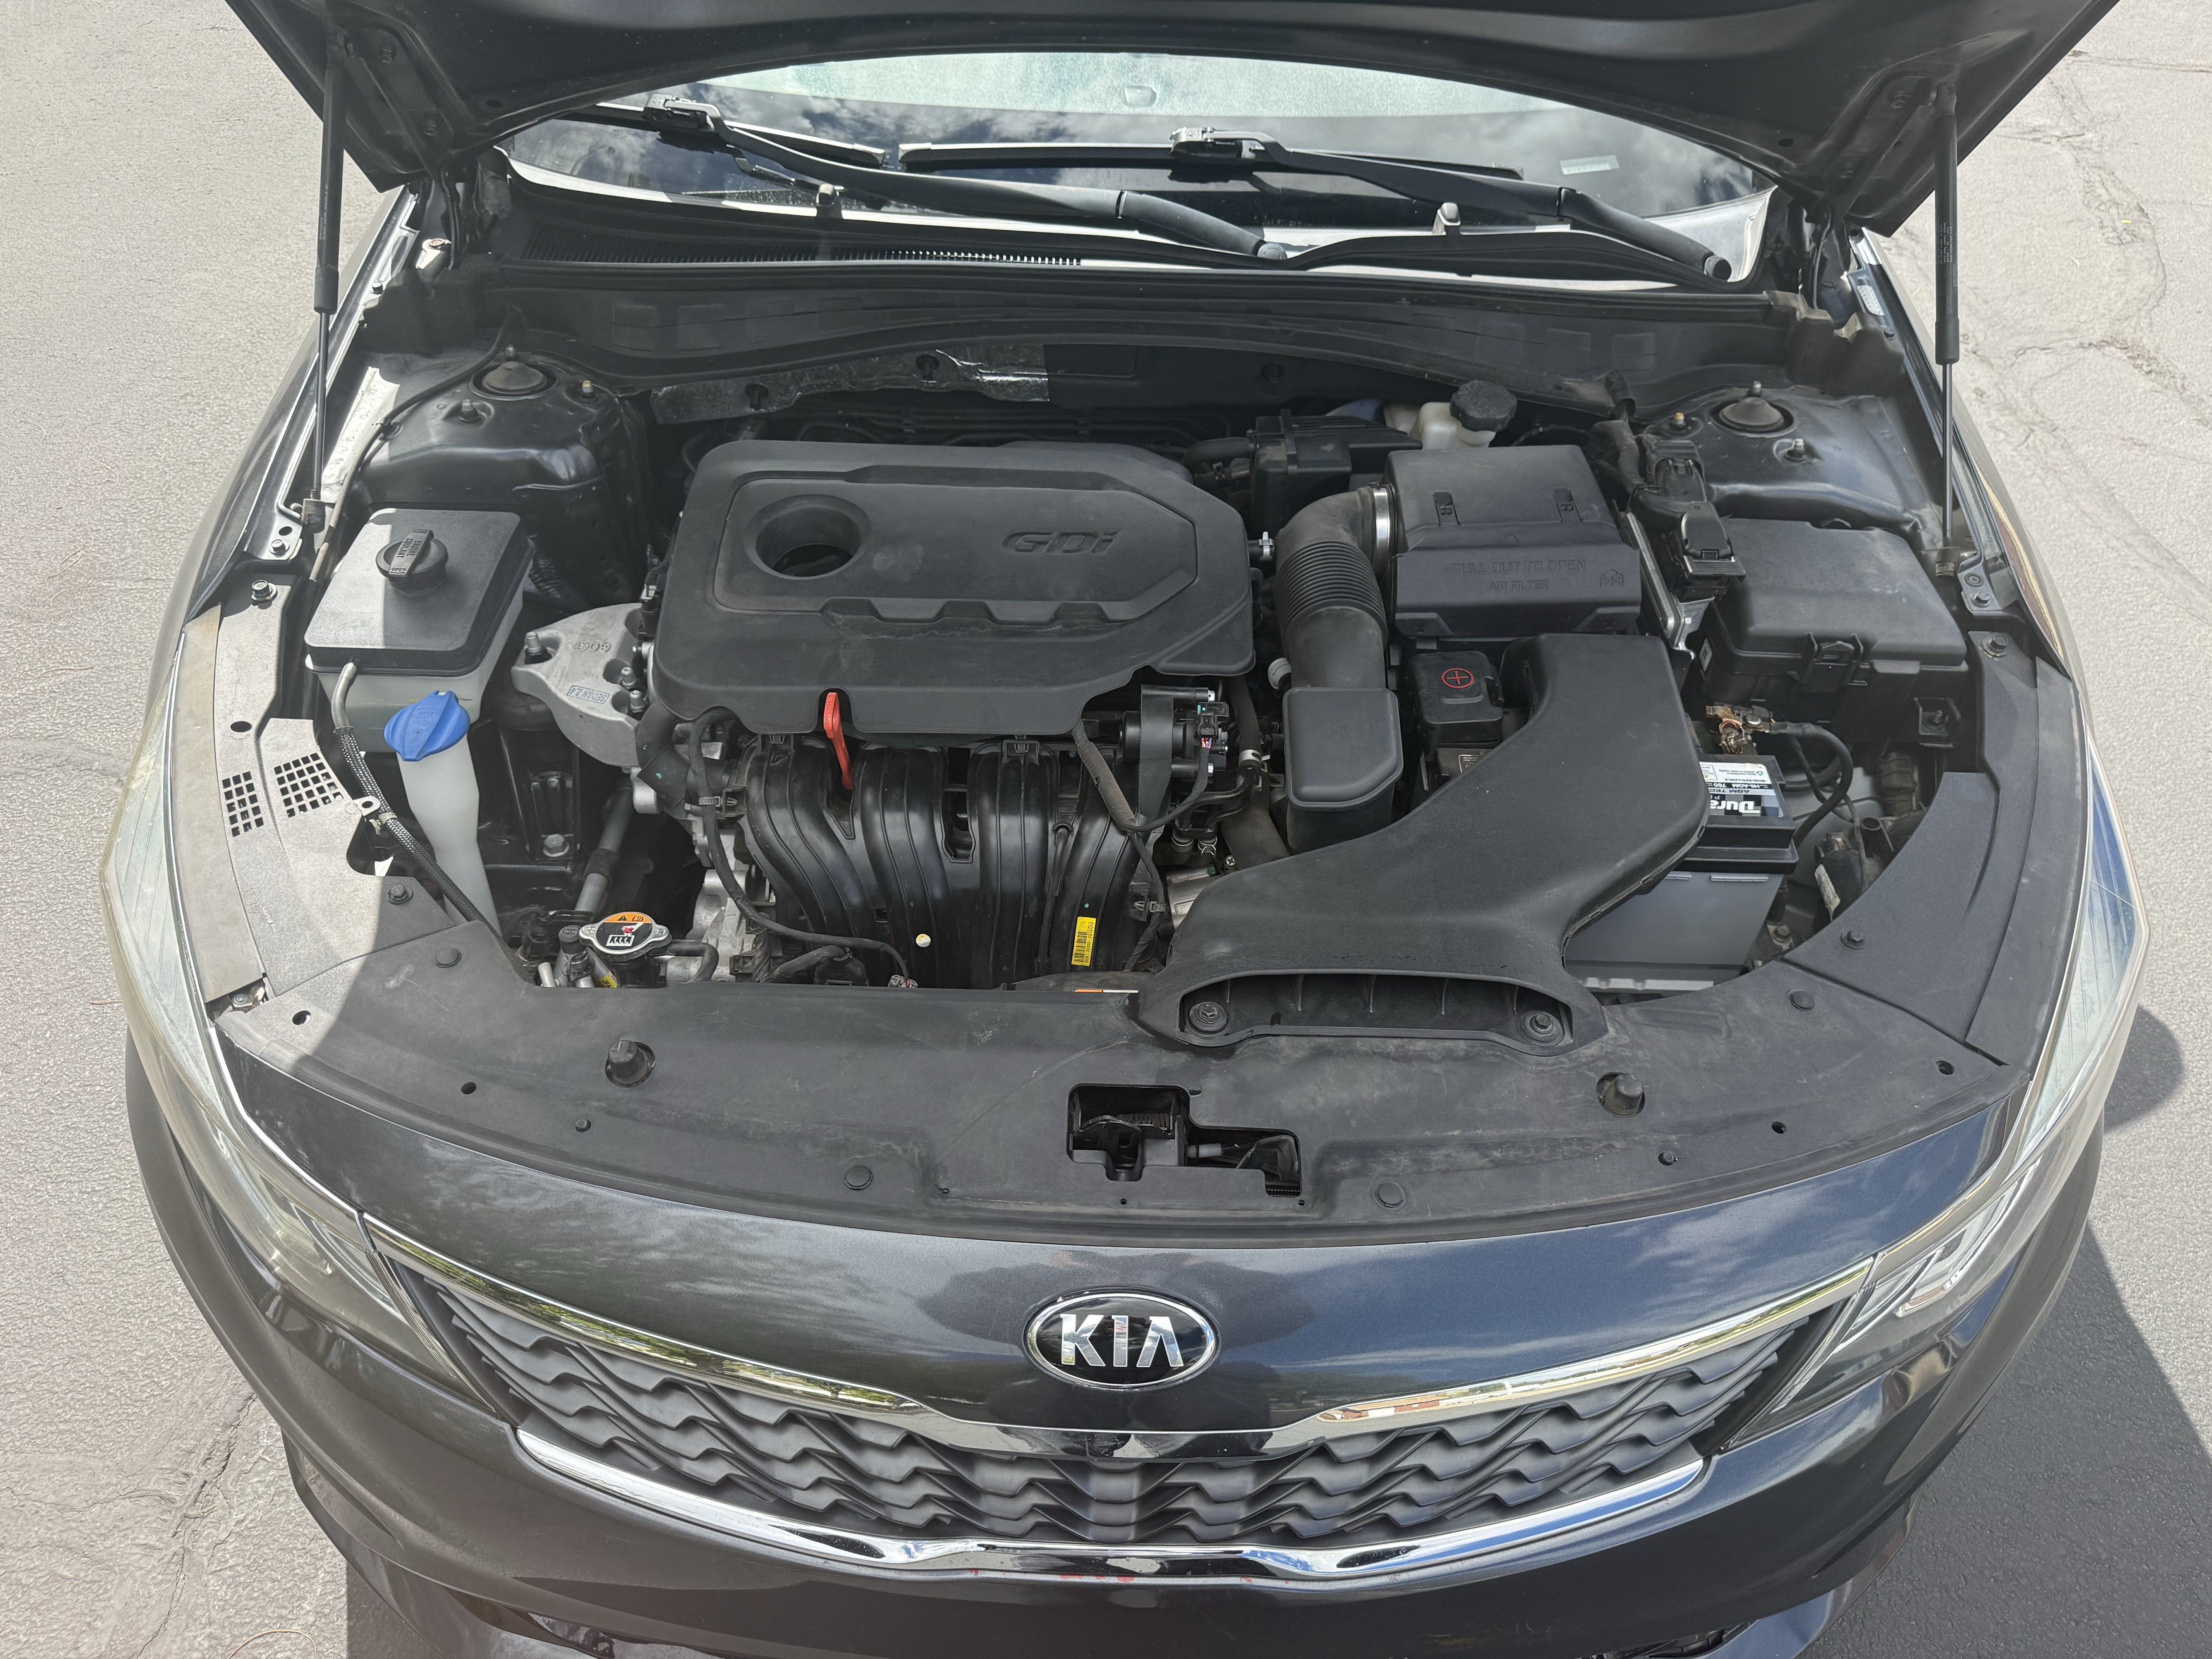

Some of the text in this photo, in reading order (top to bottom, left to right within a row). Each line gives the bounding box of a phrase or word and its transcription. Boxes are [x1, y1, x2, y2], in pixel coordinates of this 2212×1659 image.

[396, 538, 414, 558] COOLANT
[1451, 559, 1585, 574] PULL OUT TO OPEN
[1489, 580, 1549, 591] AIR FILTER
[582, 690, 607, 702] SEDAN
[1060, 1314, 1184, 1367] KIA
